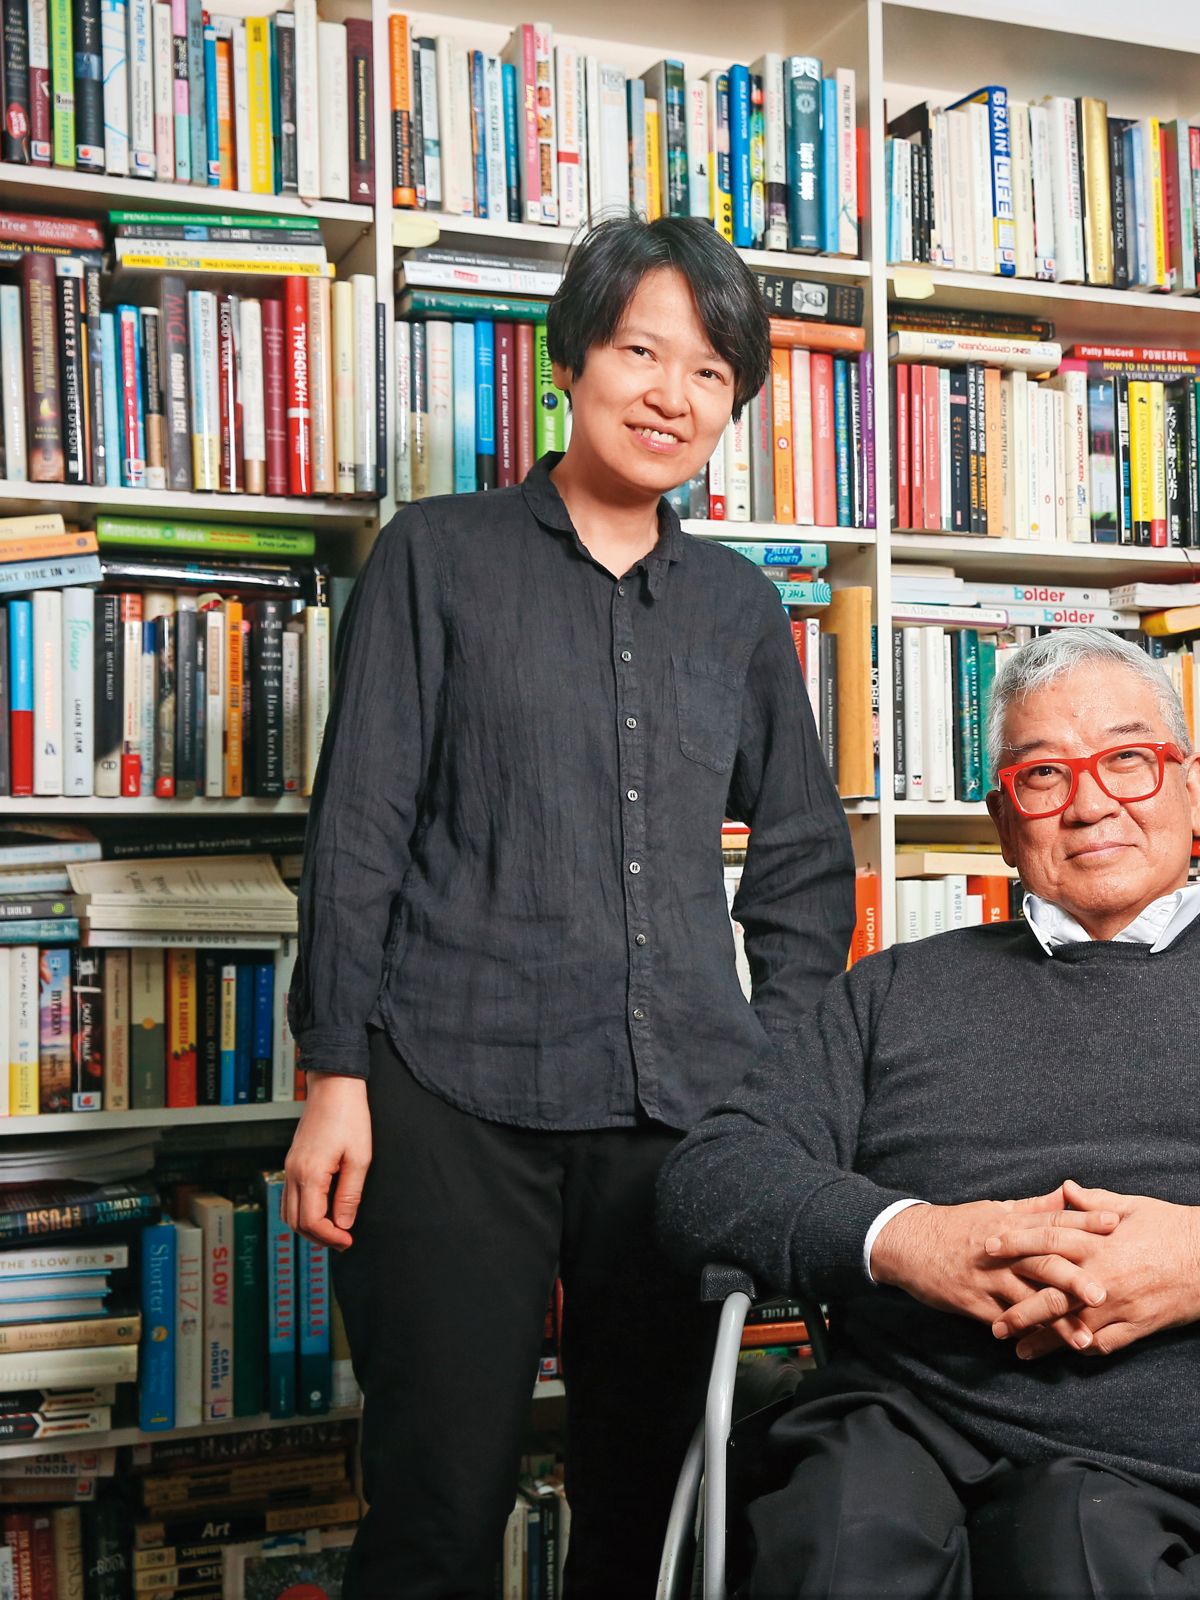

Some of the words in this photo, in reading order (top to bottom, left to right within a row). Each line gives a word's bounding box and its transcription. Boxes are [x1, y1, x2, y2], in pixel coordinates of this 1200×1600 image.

[740, 102, 749, 139] SURVIVOR
[992, 90, 1009, 152] BRAIN
[996, 161, 1012, 213] LIFE
[1115, 175, 1125, 203] MADE
[1115, 206, 1125, 220] TO
[0, 219, 27, 234] Tree
[1116, 221, 1126, 249] STICK
[64, 280, 77, 335] RELEASE
[165, 294, 188, 344] MICE
[221, 302, 231, 339] BLOOD
[65, 338, 77, 357] 2.0
[1081, 346, 1102, 357] Patty
[1103, 347, 1134, 358] McCord
[1142, 349, 1190, 362] POWERFUL
[292, 322, 307, 401] HARDBALL
[500, 354, 509, 372] WHAT
[539, 336, 553, 387] DECISIVE
[968, 367, 976, 381] THE
[1103, 361, 1123, 371] HOW
[1124, 362, 1136, 372] TO
[1137, 363, 1149, 373] FIX
[1151, 363, 1166, 374] THE
[1167, 364, 1198, 375] FUTURE
[66, 366, 78, 411] ESTHER
[171, 353, 185, 399] GORDON
[501, 373, 509, 384] THE
[977, 370, 985, 384] THE
[501, 385, 510, 399] BEST
[968, 382, 976, 408] CRAZY
[977, 385, 985, 411] CRAZY
[501, 400, 510, 427] COLLEGE
[968, 409, 976, 429] BUSY
[977, 411, 986, 431] BUSY
[67, 413, 79, 454] DYSON
[502, 429, 511, 458] TEACHERS
[969, 430, 977, 451] CURE
[978, 432, 986, 453] CURE
[502, 459, 511, 469] DO
[1076, 426, 1085, 482] CRYPTOQUEEN
[970, 474, 979, 509] EVERETT
[979, 476, 987, 511] EVERETT
[176, 526, 205, 542] Work
[1013, 587, 1066, 603] bolder
[104, 601, 113, 620] THE
[1044, 608, 1096, 624] bolder
[105, 622, 114, 643] RITE
[894, 632, 903, 645] THE
[105, 651, 114, 672] MATT
[894, 646, 903, 658] NO
[970, 645, 980, 697] ACQUAINTED
[895, 686, 904, 702] RULE
[971, 699, 980, 721] WITH
[972, 724, 981, 740] THE
[267, 728, 280, 778] Kurshan
[972, 742, 982, 768] NIGHT
[114, 845, 141, 855] Dawn
[198, 837, 252, 851] Everything
[866, 907, 875, 953] UTOPIA
[909, 911, 919, 939] maid
[50, 989, 63, 1036] HYPERION
[206, 1041, 216, 1061] OFF
[206, 1064, 216, 1100] SEASON
[26, 1207, 67, 1235] PUSH
[0, 1259, 25, 1270] THE
[32, 1256, 70, 1268] SLOW
[76, 1255, 97, 1266] FIX
[241, 1235, 257, 1286] Expert
[149, 1244, 168, 1313] Shorter
[212, 1246, 228, 1306] SLOW
[211, 1341, 221, 1390] HONORÉ
[221, 1349, 229, 1378] CARL
[201, 1521, 231, 1540] Art
